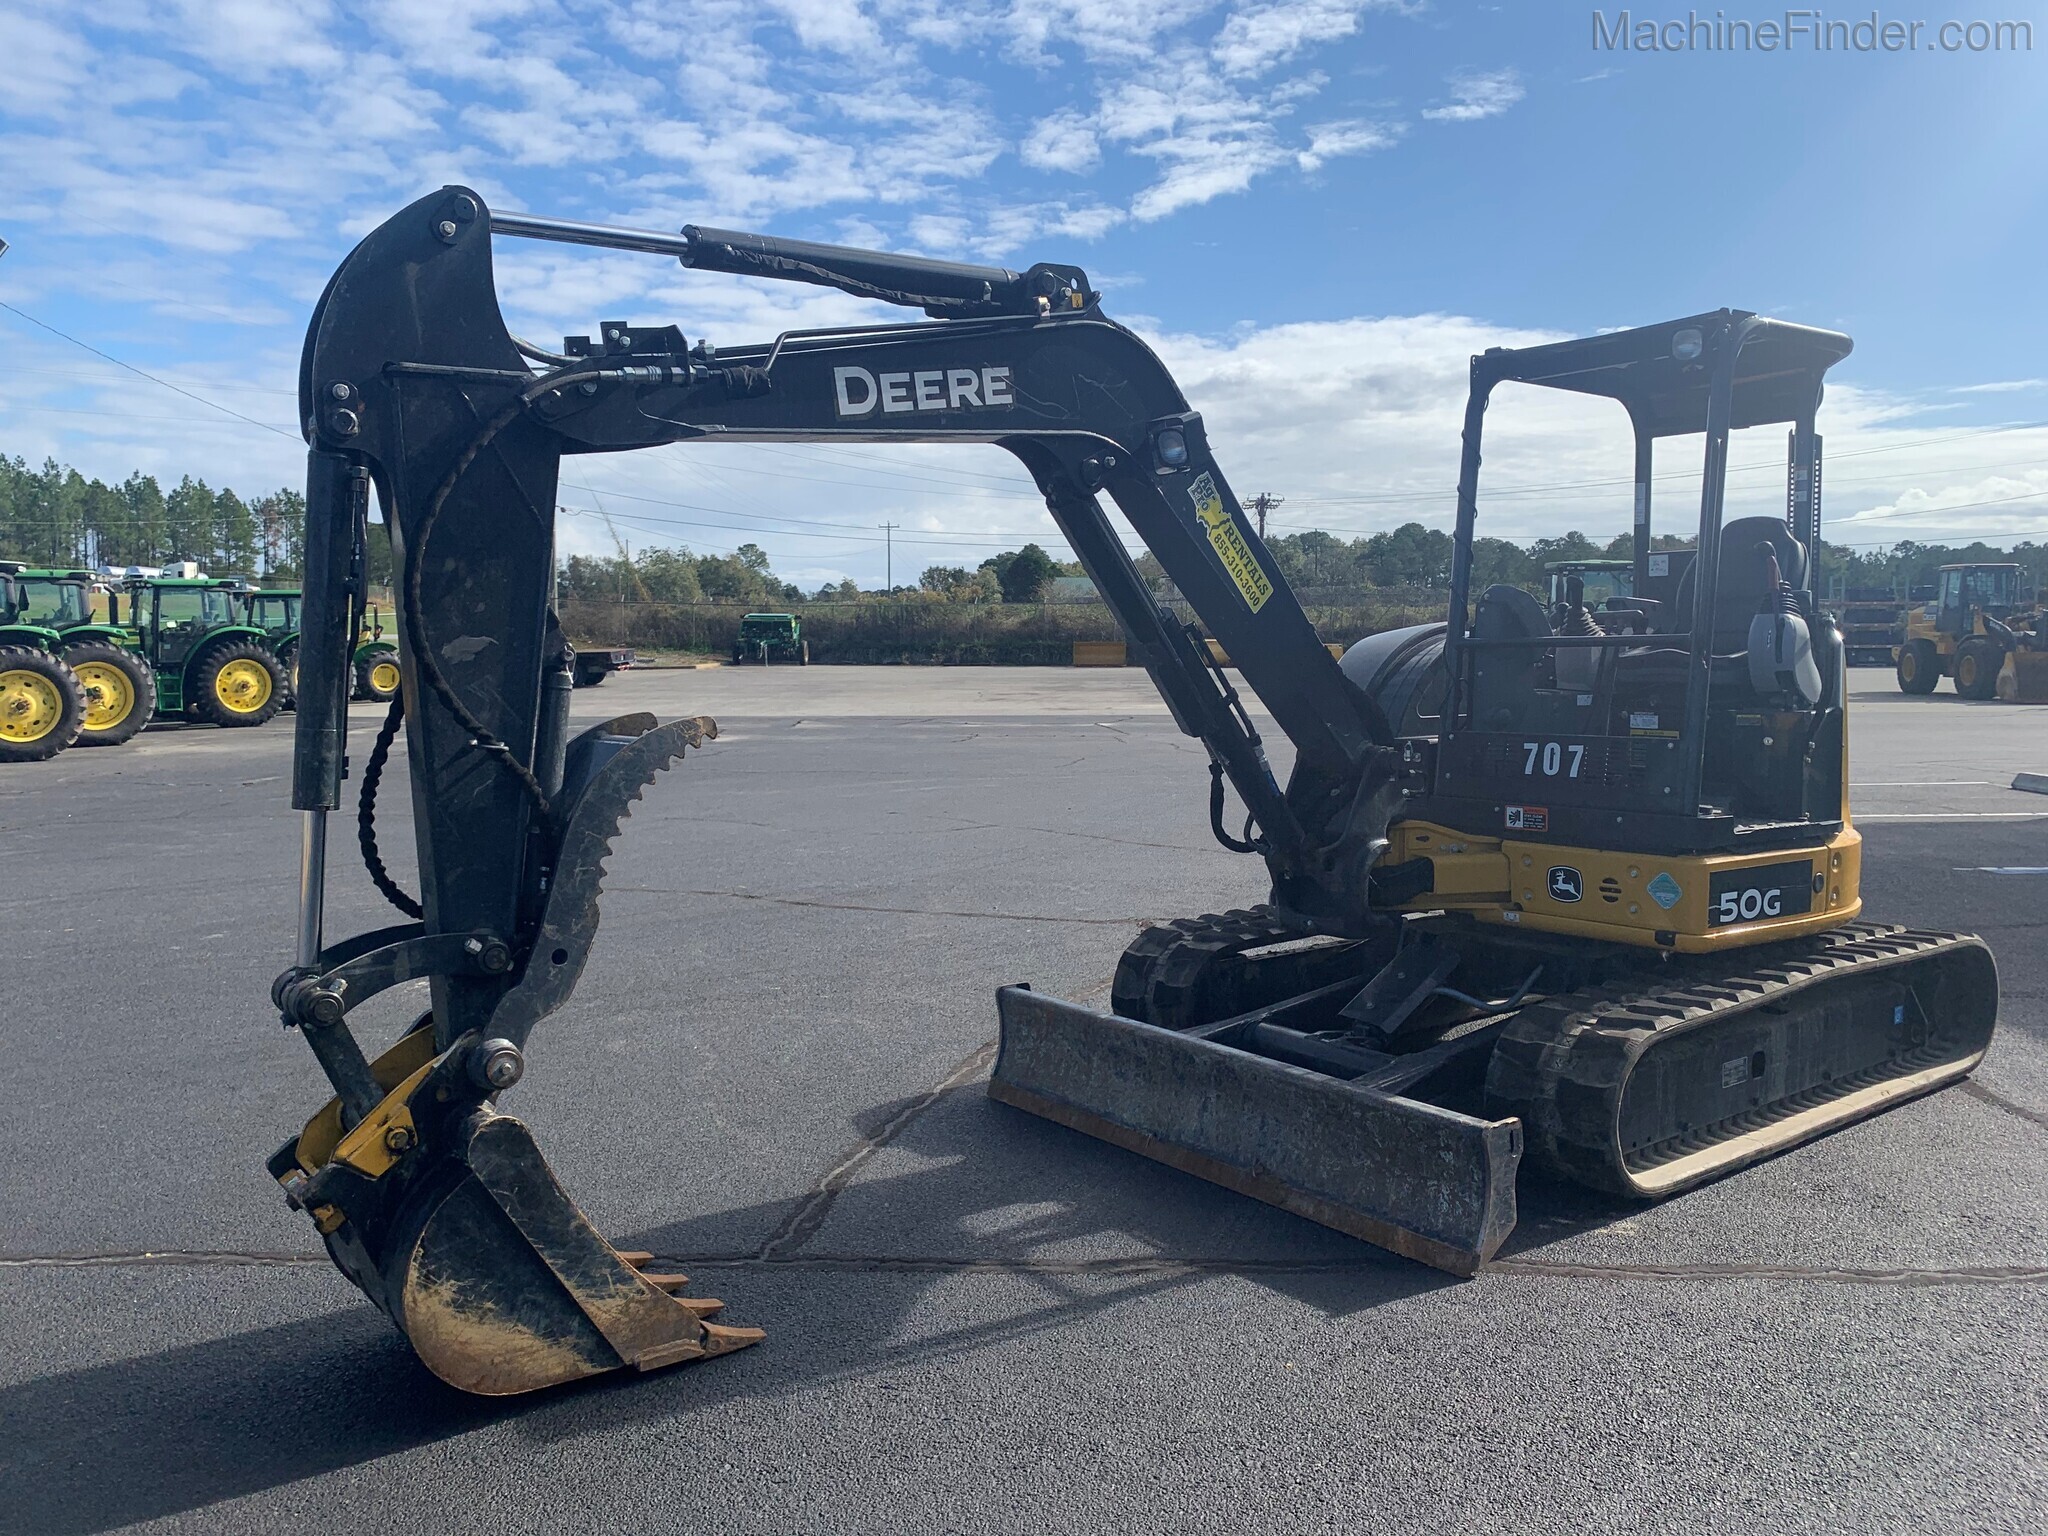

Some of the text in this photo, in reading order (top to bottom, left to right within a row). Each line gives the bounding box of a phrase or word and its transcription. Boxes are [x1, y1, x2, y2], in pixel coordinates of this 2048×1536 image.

[833, 366, 1013, 416] DEERE
[1213, 534, 1260, 607] 855-310-3600
[1224, 526, 1269, 596] RENTALS
[1523, 742, 1584, 778] 707
[1719, 888, 1781, 923] 50G
